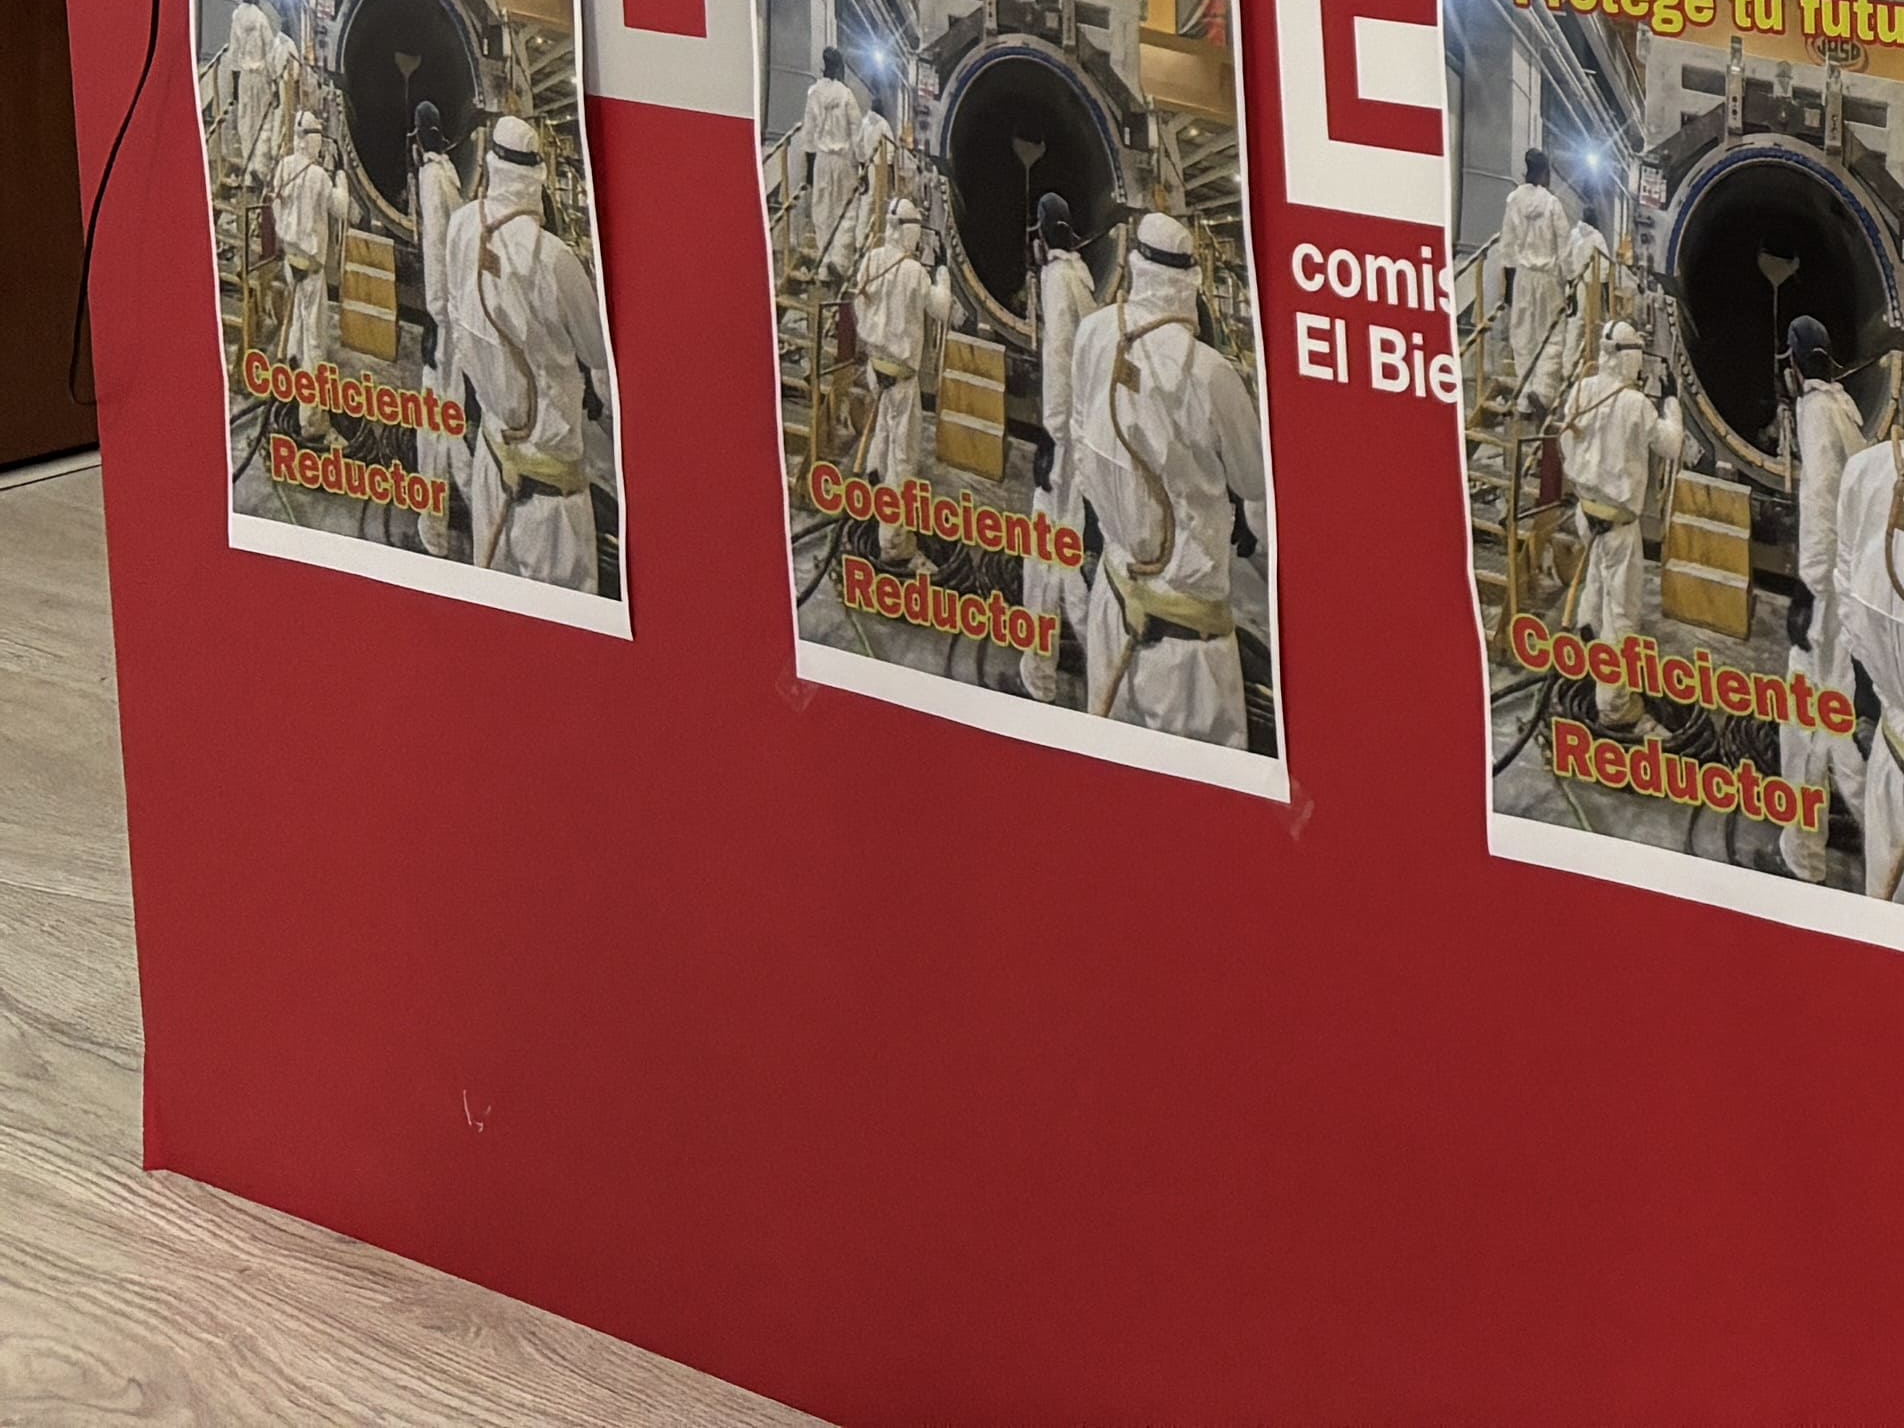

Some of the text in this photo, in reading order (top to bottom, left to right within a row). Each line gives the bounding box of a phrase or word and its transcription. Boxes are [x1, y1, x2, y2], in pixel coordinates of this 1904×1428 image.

[243, 349, 467, 437] Coeficiente
[1296, 310, 1349, 385] El
[270, 435, 449, 516] Reductor
[809, 461, 1084, 567] Coeficiente
[842, 556, 1058, 655] Reductor
[1509, 612, 1857, 736] Coeficiente
[1552, 718, 1827, 832] Reductor
